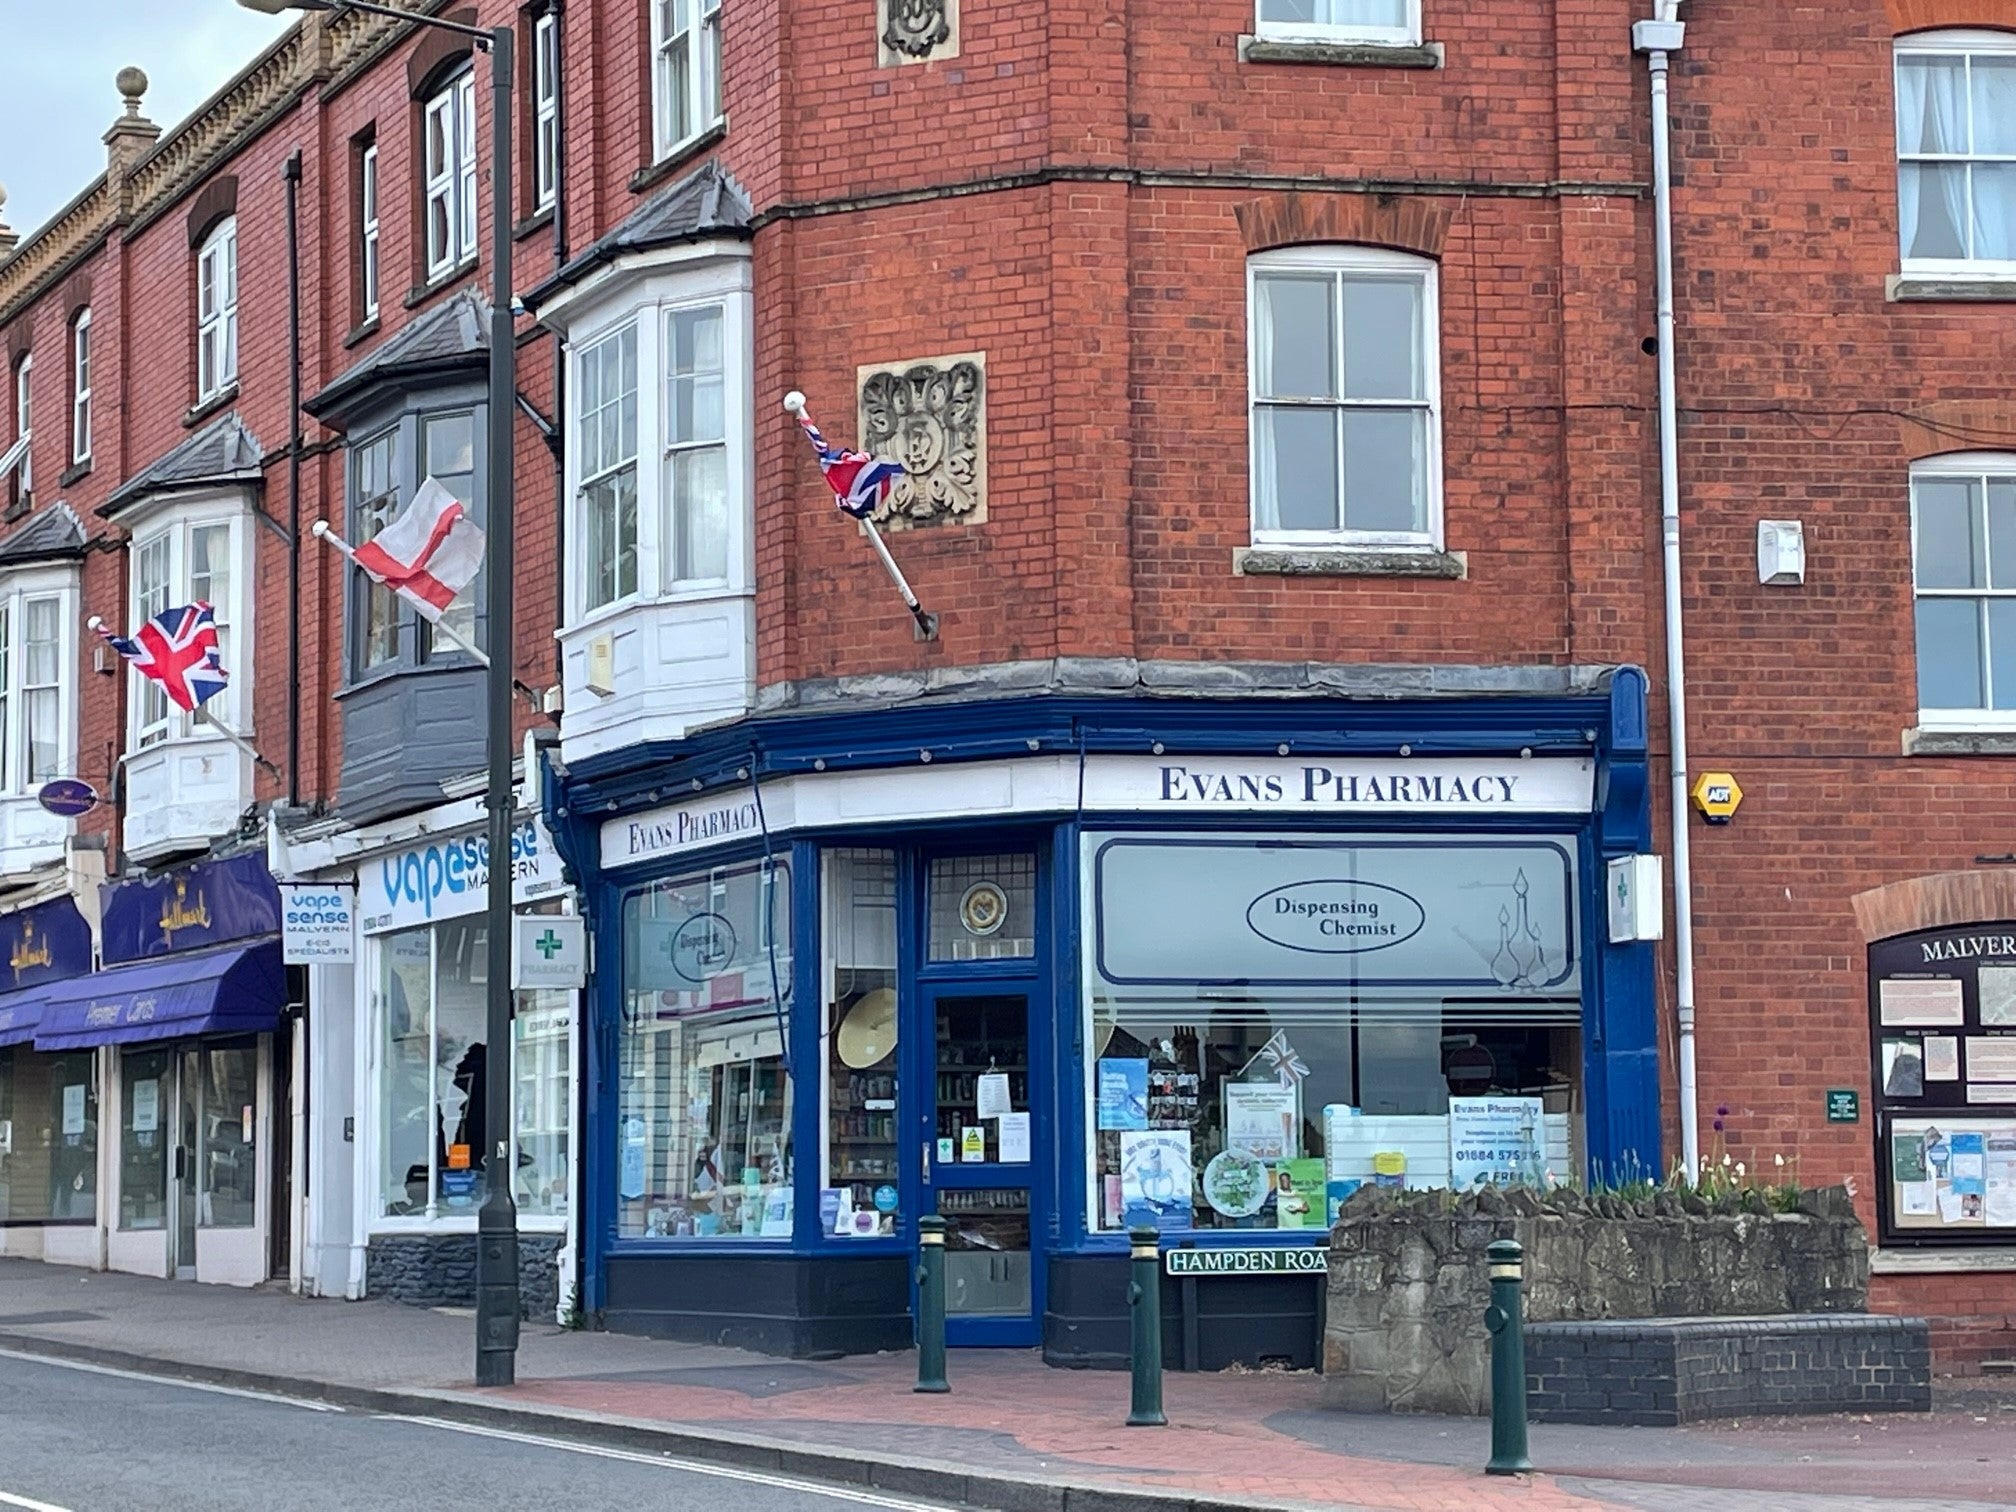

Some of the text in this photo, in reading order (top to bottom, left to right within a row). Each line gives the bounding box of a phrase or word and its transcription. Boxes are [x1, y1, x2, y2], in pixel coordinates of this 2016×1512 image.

[1159, 766, 1519, 803] EVANS PHARMACY
[1709, 787, 1730, 802] ADT
[629, 803, 759, 854] EVANS PHARMACY
[464, 821, 537, 870] sese
[467, 858, 539, 891] MAERN
[291, 895, 342, 911] vape
[1275, 897, 1379, 918] Dispensing
[287, 911, 348, 924] sense
[1319, 918, 1396, 936] Chemist
[287, 947, 350, 955] SPECIALISTS
[1921, 936, 2016, 962] MALVER
[1173, 1251, 1276, 1270] HAMPDEN
